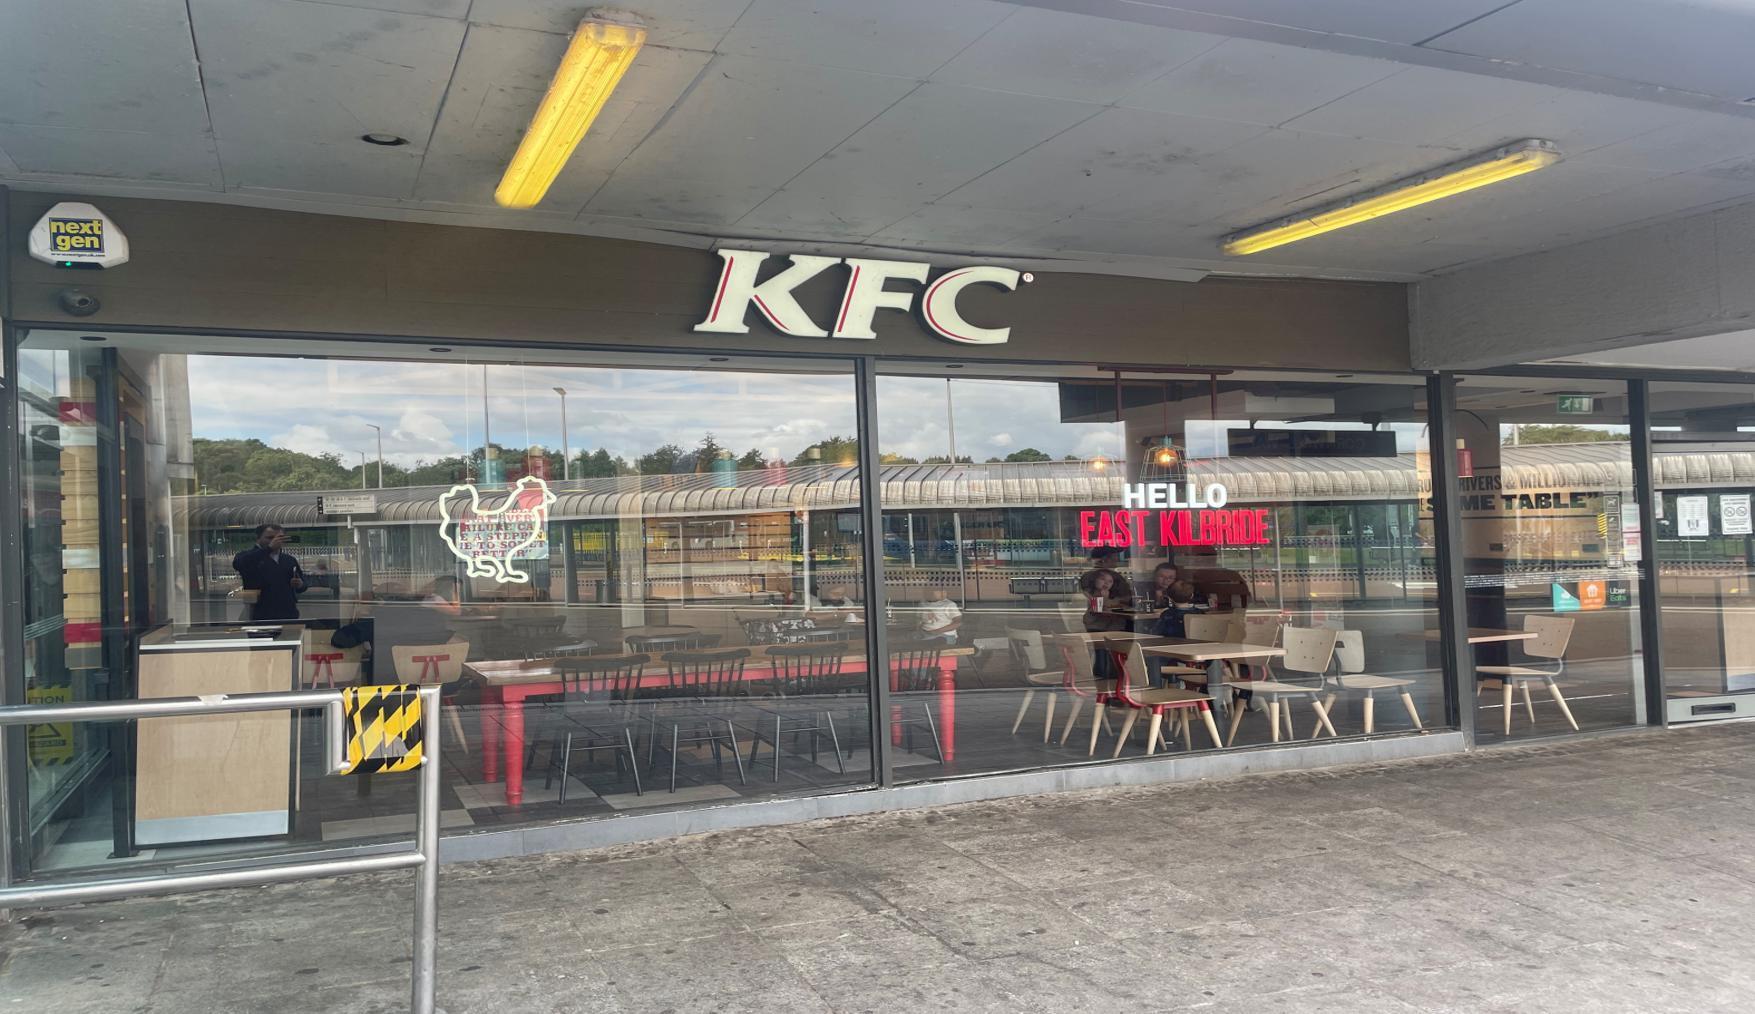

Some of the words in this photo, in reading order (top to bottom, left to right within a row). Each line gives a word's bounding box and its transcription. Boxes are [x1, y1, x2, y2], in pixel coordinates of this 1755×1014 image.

[50, 220, 101, 235] next
[56, 235, 99, 251] gen
[693, 248, 1021, 345] KFC
[1124, 483, 1228, 508] HELLO
[1080, 510, 1150, 547] EAST
[1159, 509, 1270, 546] KILBRIDE
